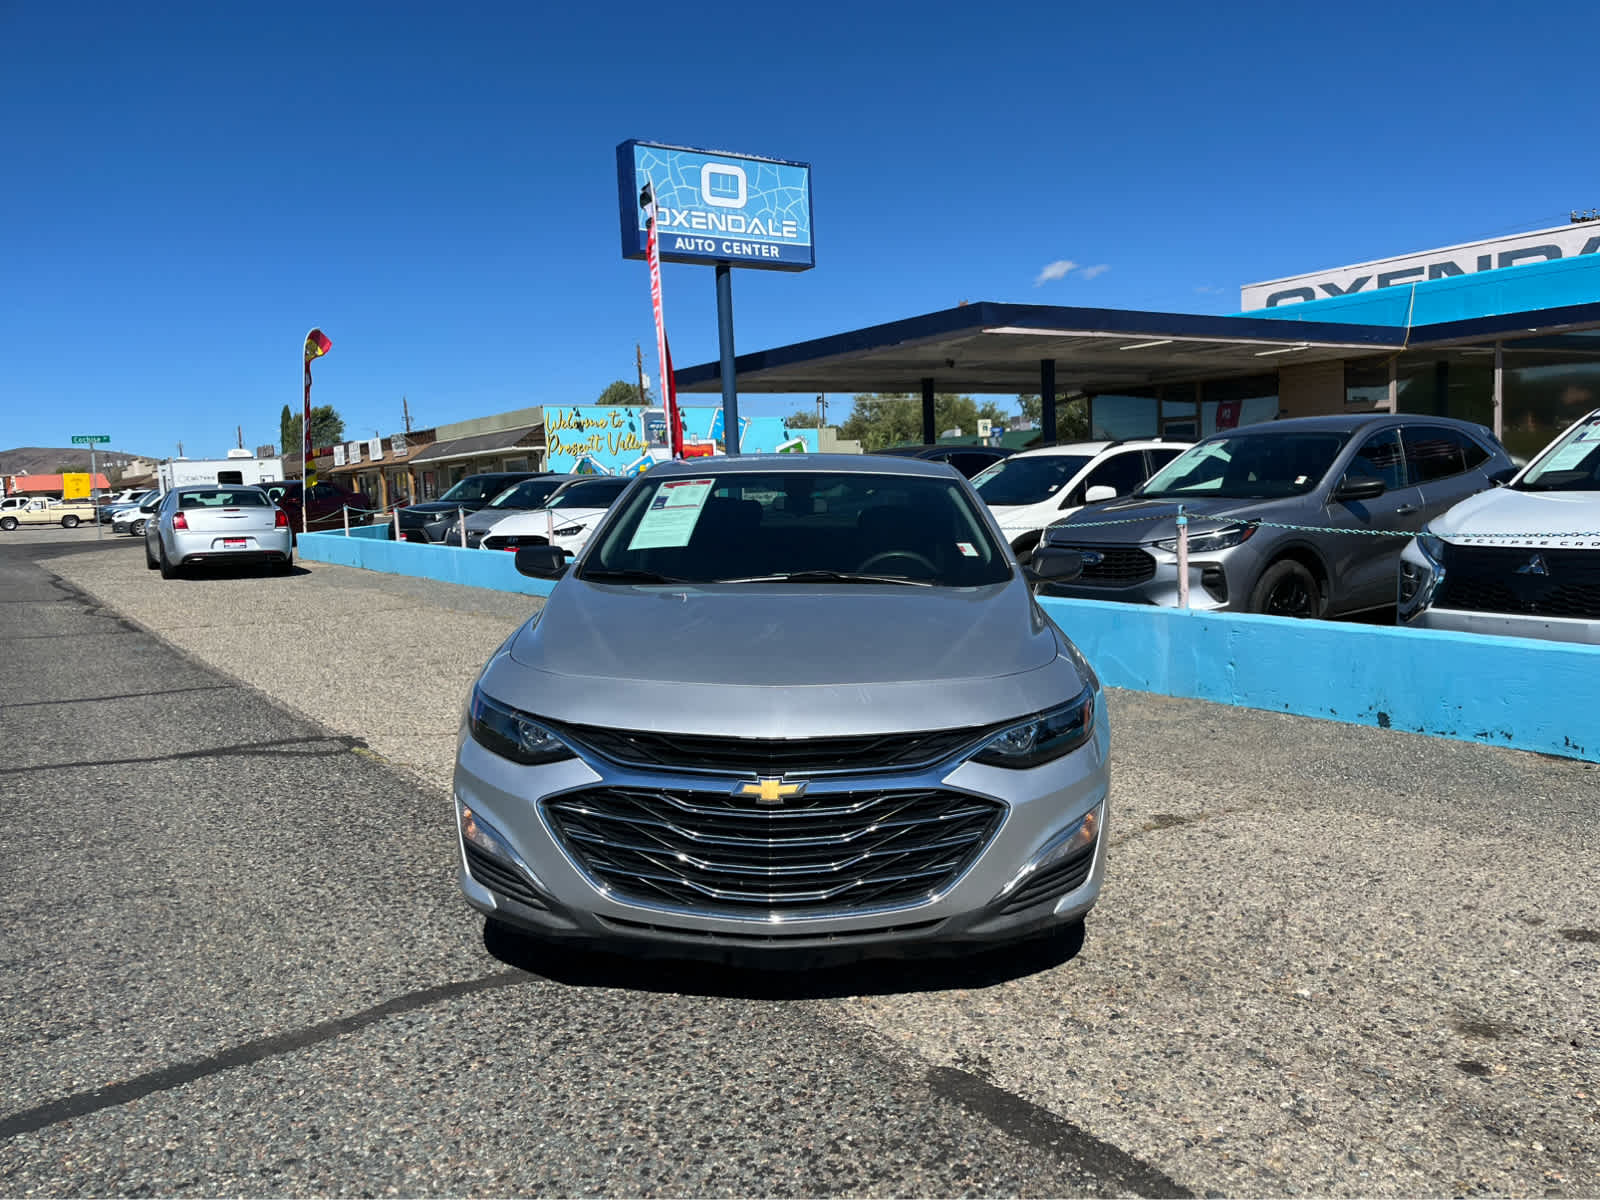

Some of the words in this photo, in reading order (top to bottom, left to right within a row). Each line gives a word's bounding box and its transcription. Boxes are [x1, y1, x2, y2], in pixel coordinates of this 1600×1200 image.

[656, 207, 797, 237] OXENDALE
[675, 237, 716, 253] AUTO
[722, 241, 780, 258] CENTER
[545, 409, 608, 434] Welcome
[608, 410, 624, 428] to
[546, 433, 604, 459] Prescott
[607, 431, 649, 456] Valley
[1463, 538, 1549, 546] ECLIPSE
